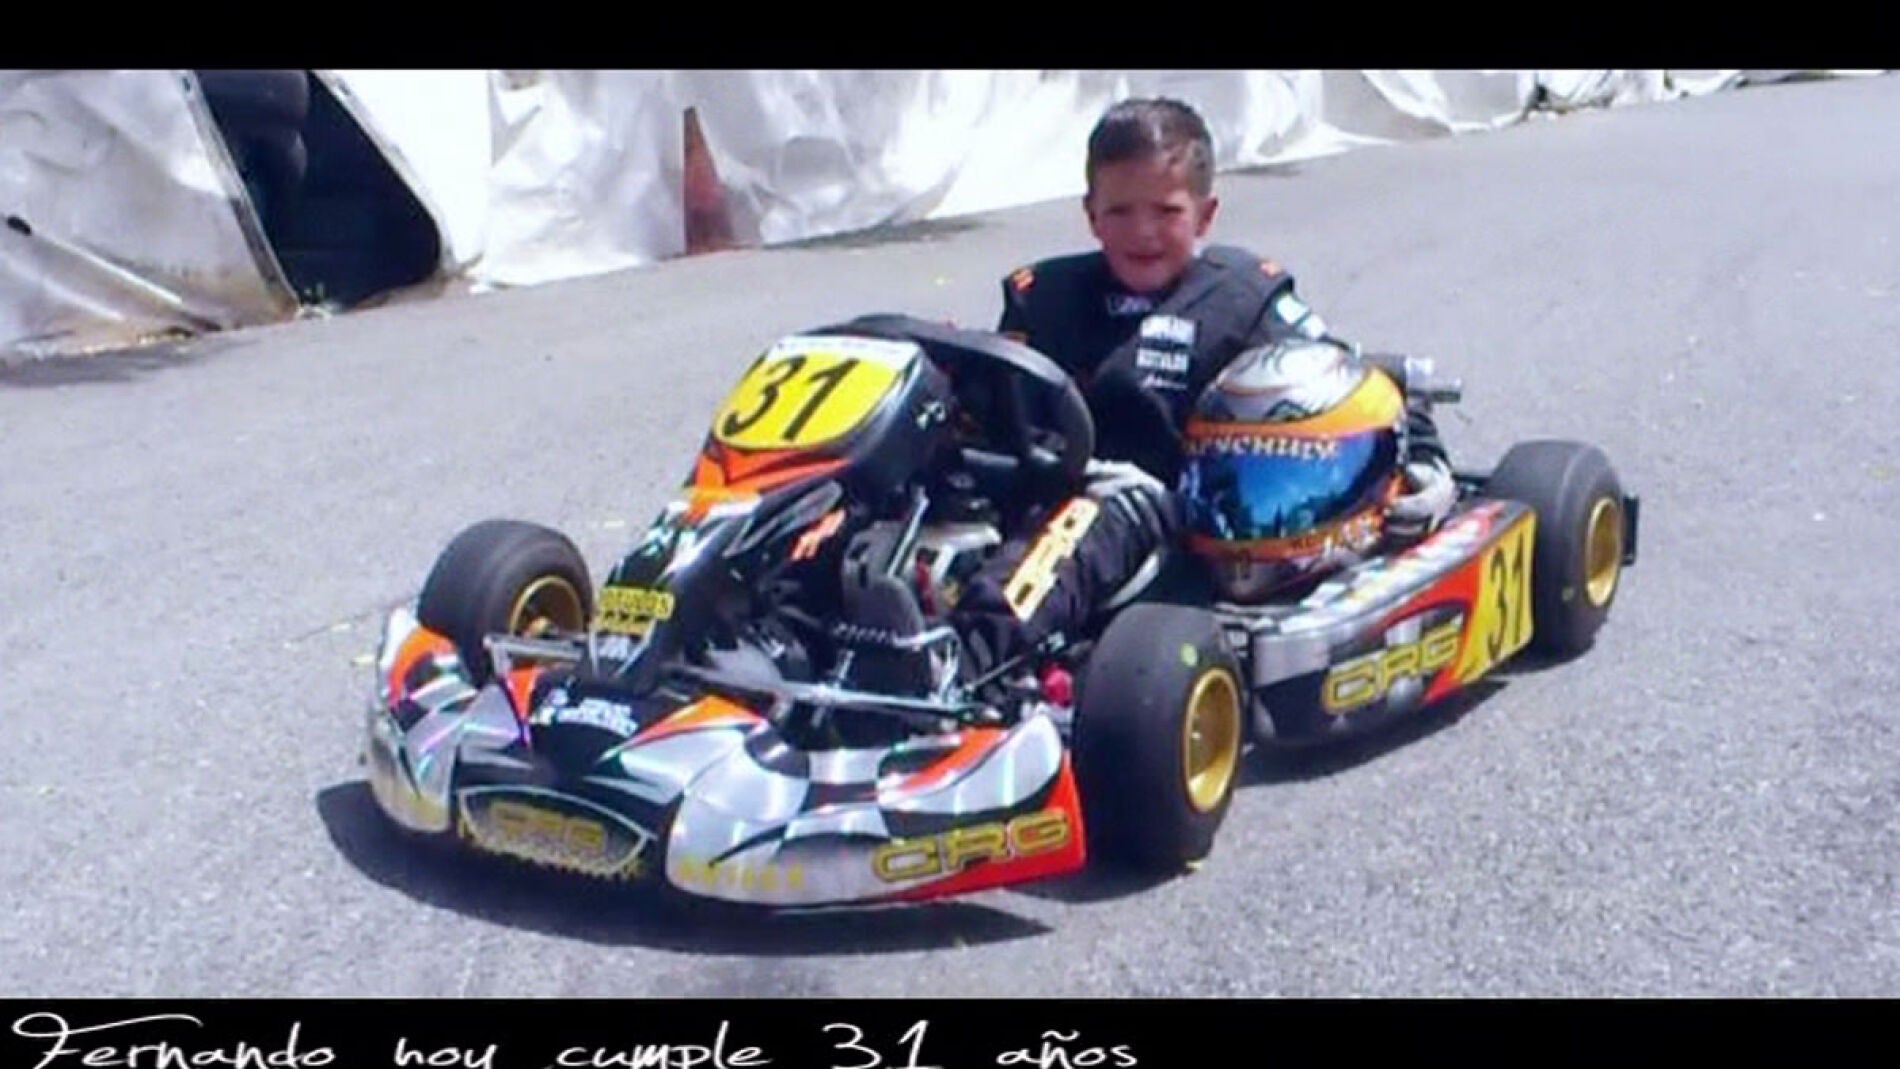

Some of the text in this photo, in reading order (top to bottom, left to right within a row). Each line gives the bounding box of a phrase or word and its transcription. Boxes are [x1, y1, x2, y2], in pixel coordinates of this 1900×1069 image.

[722, 354, 862, 442] 31
[1485, 526, 1527, 662] 31
[1320, 622, 1461, 716] CRG
[871, 808, 1070, 884] CRG
